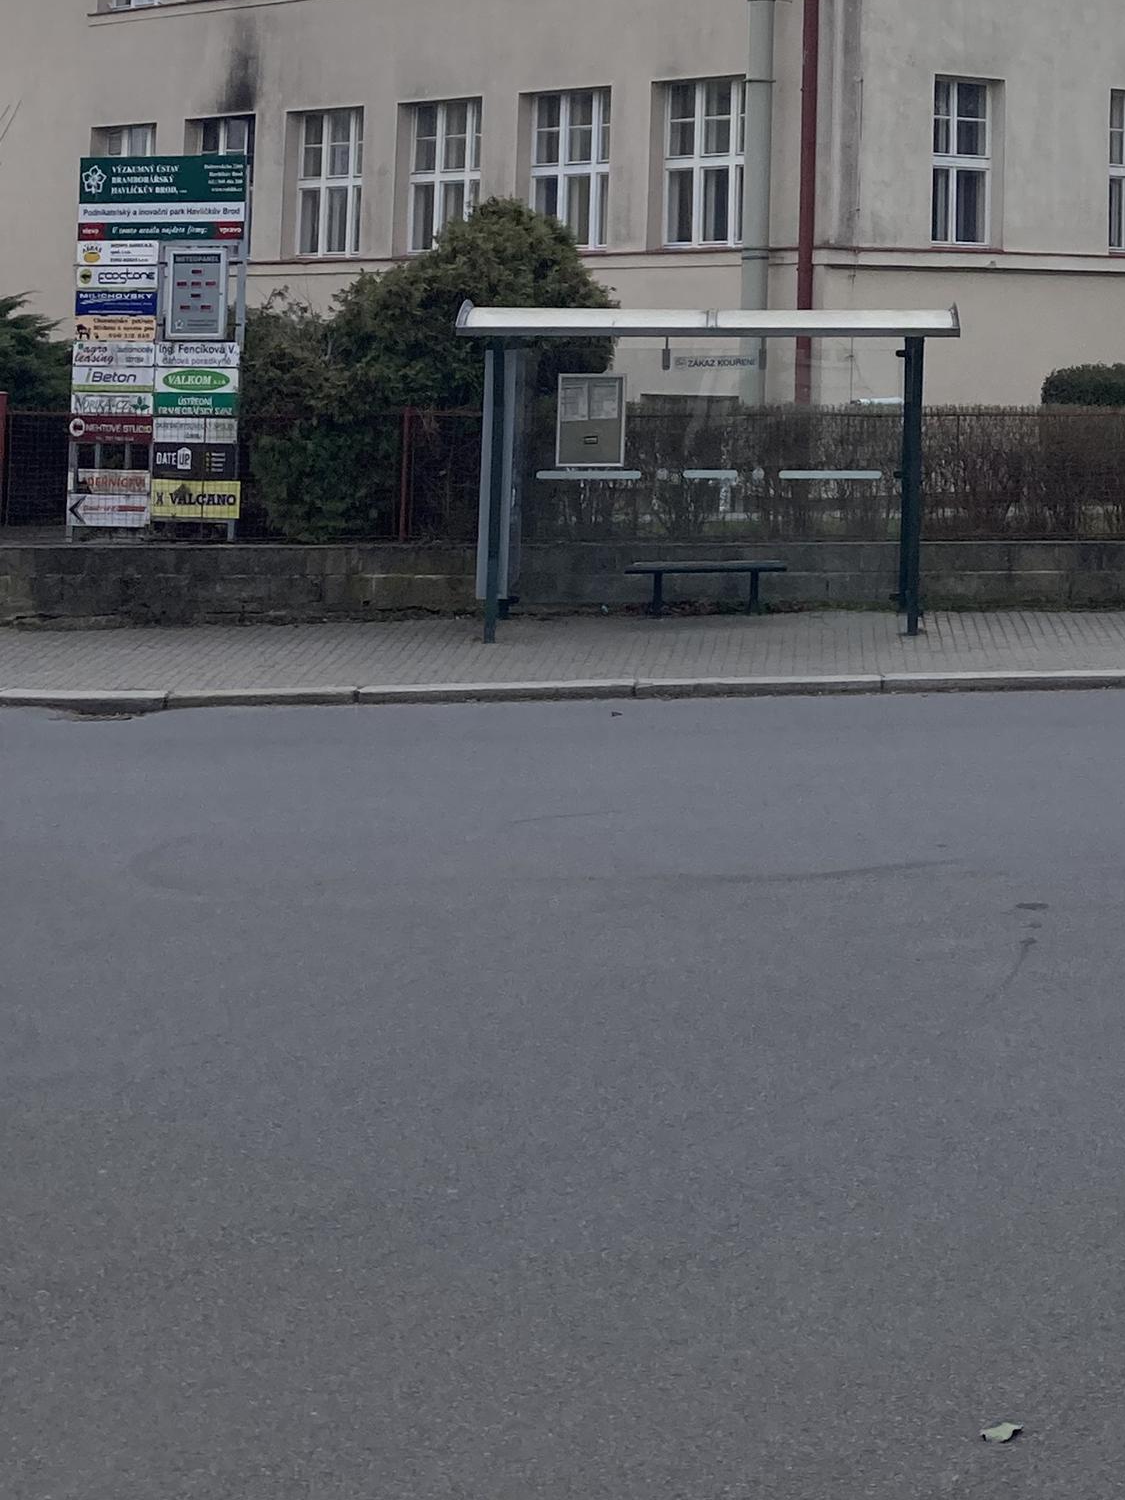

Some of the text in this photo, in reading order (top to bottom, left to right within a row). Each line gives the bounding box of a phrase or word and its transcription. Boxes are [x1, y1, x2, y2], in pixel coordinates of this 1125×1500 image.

[156, 163, 180, 173] ÚSTAV
[138, 207, 168, 216] inovační
[169, 208, 185, 217] park
[222, 207, 240, 215] Brod
[85, 368, 137, 383] iBeton
[168, 375, 212, 385] VALKOM
[156, 452, 191, 466] DATE UP
[170, 492, 237, 506] VALCANO
